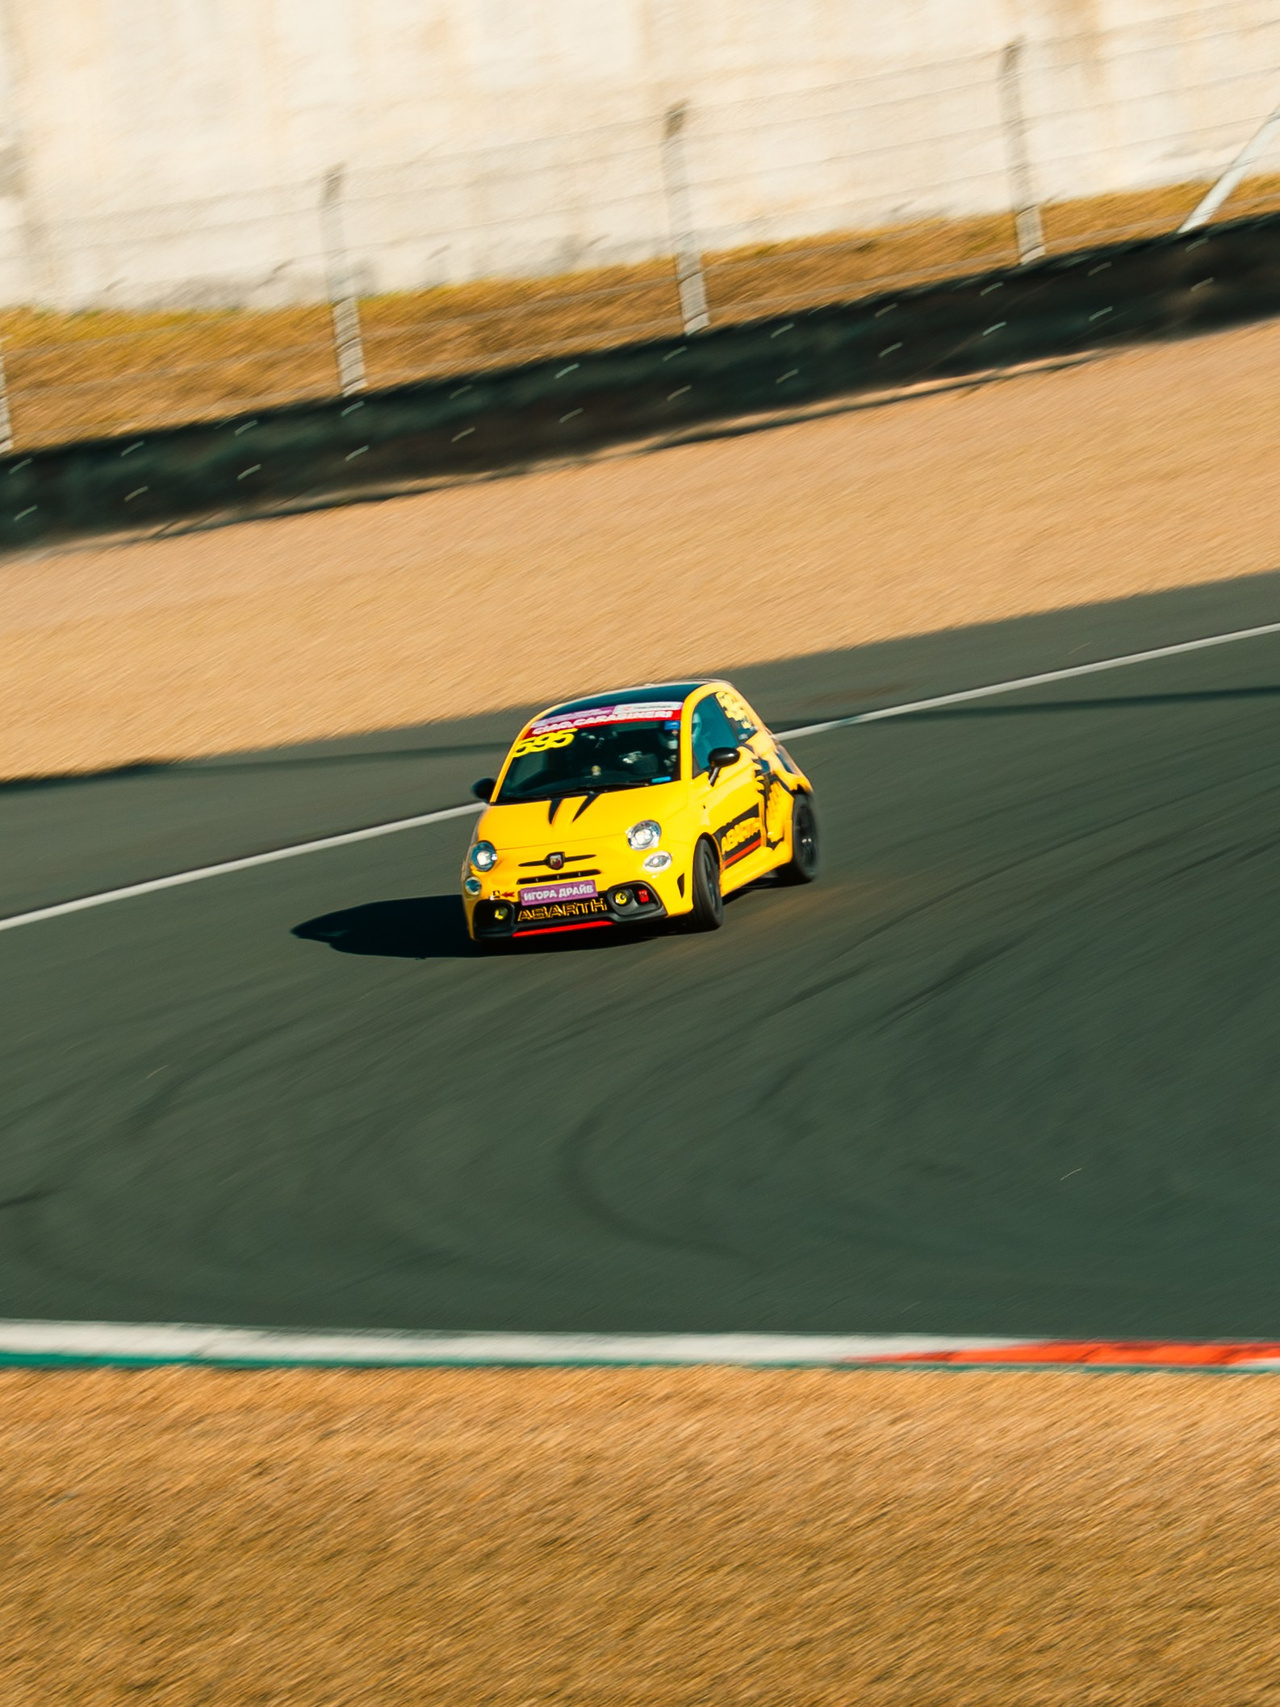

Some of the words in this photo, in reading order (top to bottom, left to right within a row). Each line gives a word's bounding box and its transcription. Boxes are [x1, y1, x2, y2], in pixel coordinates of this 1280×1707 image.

[512, 727, 578, 758] 595
[523, 889, 557, 902] ИГОРА
[559, 884, 594, 898] ДРАЙВ
[517, 897, 608, 922] ABARTH
